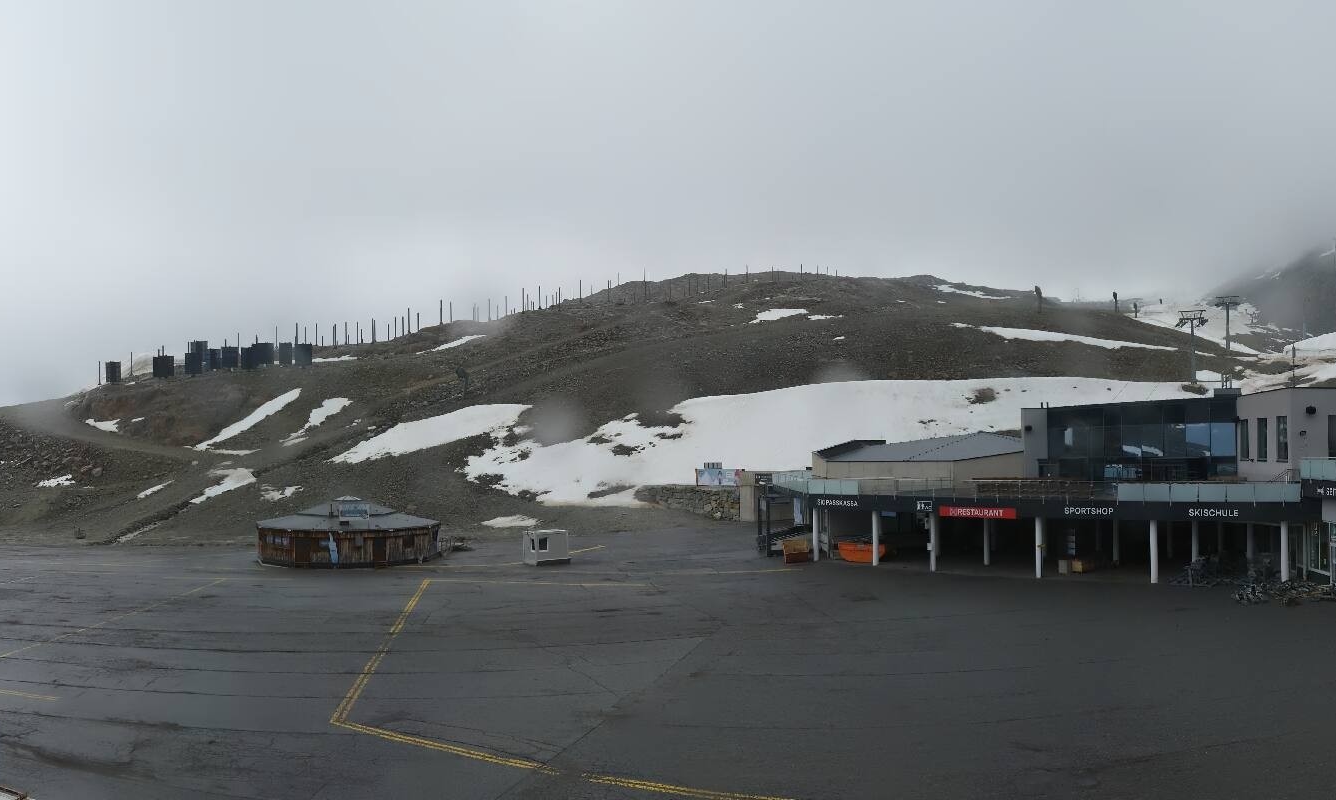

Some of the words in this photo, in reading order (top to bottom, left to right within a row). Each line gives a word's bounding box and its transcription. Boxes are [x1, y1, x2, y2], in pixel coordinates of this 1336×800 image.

[957, 508, 1003, 517] RESTAURANT
[1064, 506, 1114, 515] SPORTSHOP
[1188, 508, 1239, 517] SKISCHULE
